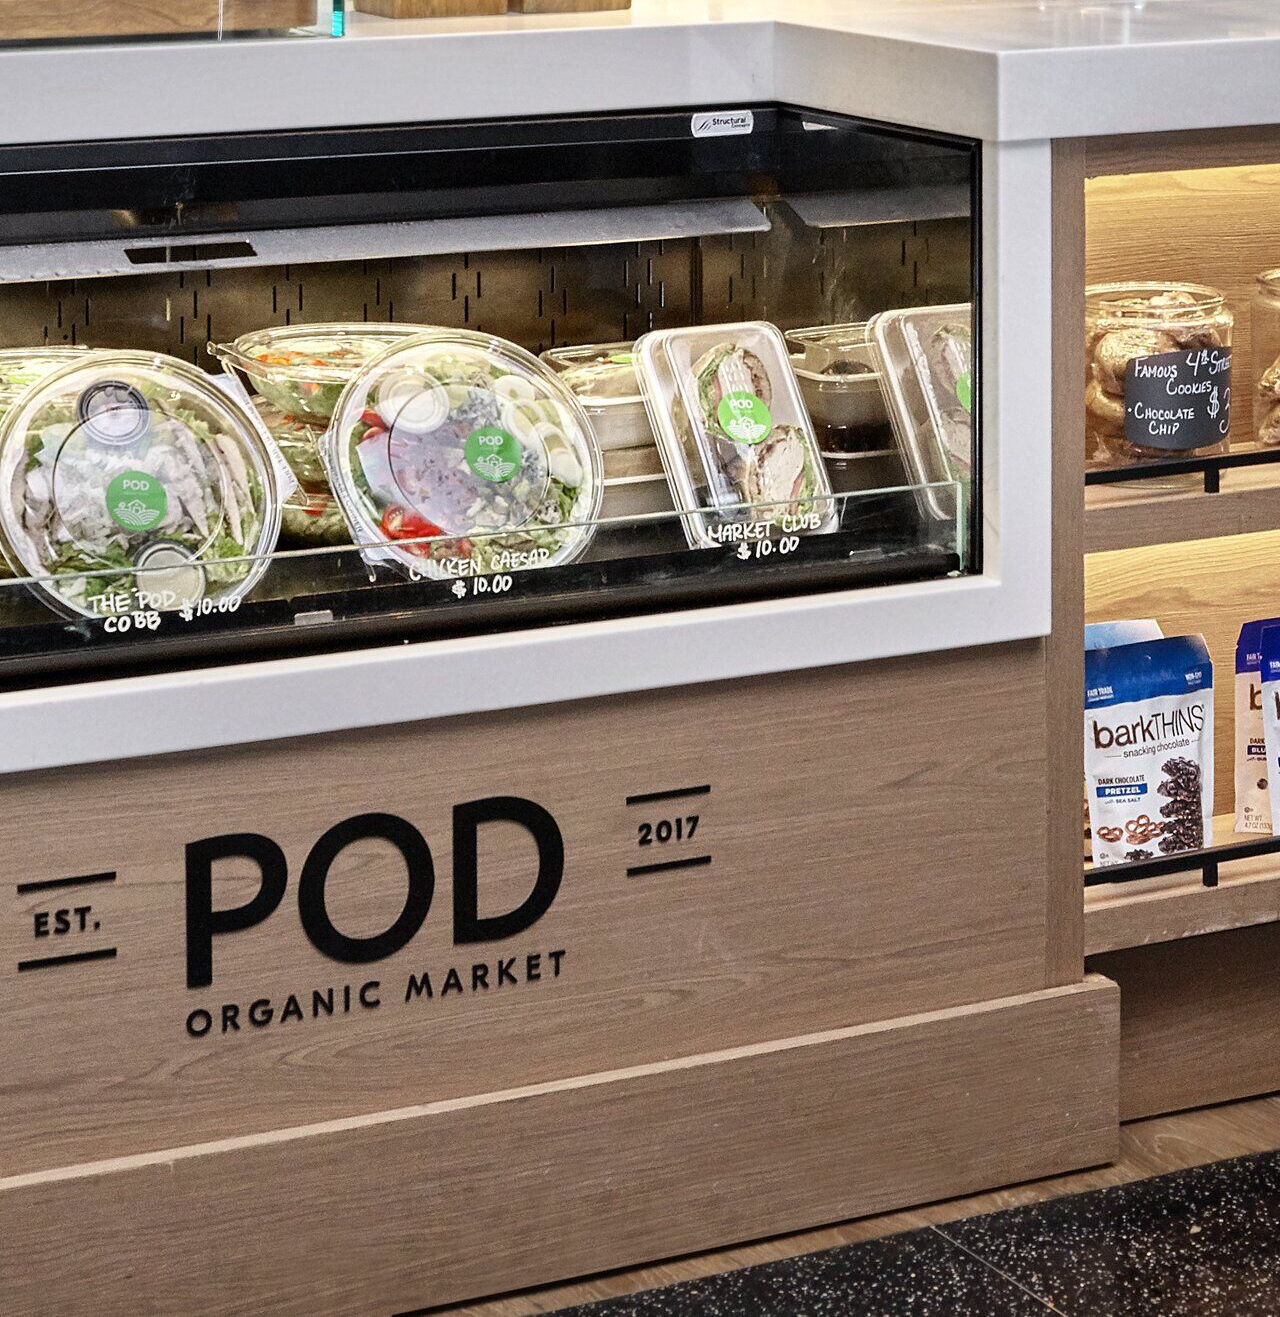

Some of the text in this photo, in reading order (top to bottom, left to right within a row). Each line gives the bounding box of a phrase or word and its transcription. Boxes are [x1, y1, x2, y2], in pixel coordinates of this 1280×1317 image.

[712, 117, 747, 125] Structural
[1134, 356, 1179, 378] FAMOUS
[1166, 377, 1213, 395] COOKIES
[729, 398, 754, 410] POD
[1134, 402, 1196, 421] CHOCOLATE
[1148, 420, 1180, 436] CHIP
[478, 435, 504, 446] POD
[122, 479, 150, 491] POD
[707, 511, 822, 544] MARKET CLUB
[489, 547, 550, 571] CAESAR
[87, 589, 177, 613] THE POD
[178, 594, 242, 622] $10.00
[103, 609, 162, 634] COBB
[1092, 703, 1205, 750] barkTHINS
[1123, 737, 1191, 759] snacking chocolate
[1098, 774, 1145, 786] DARK CHOCOLATE
[1104, 785, 1141, 795] PRETZEL
[636, 815, 702, 847] 2017
[183, 795, 565, 991] POD
[32, 905, 103, 940] EST.
[185, 948, 568, 1040] ORGANIC MARKET
